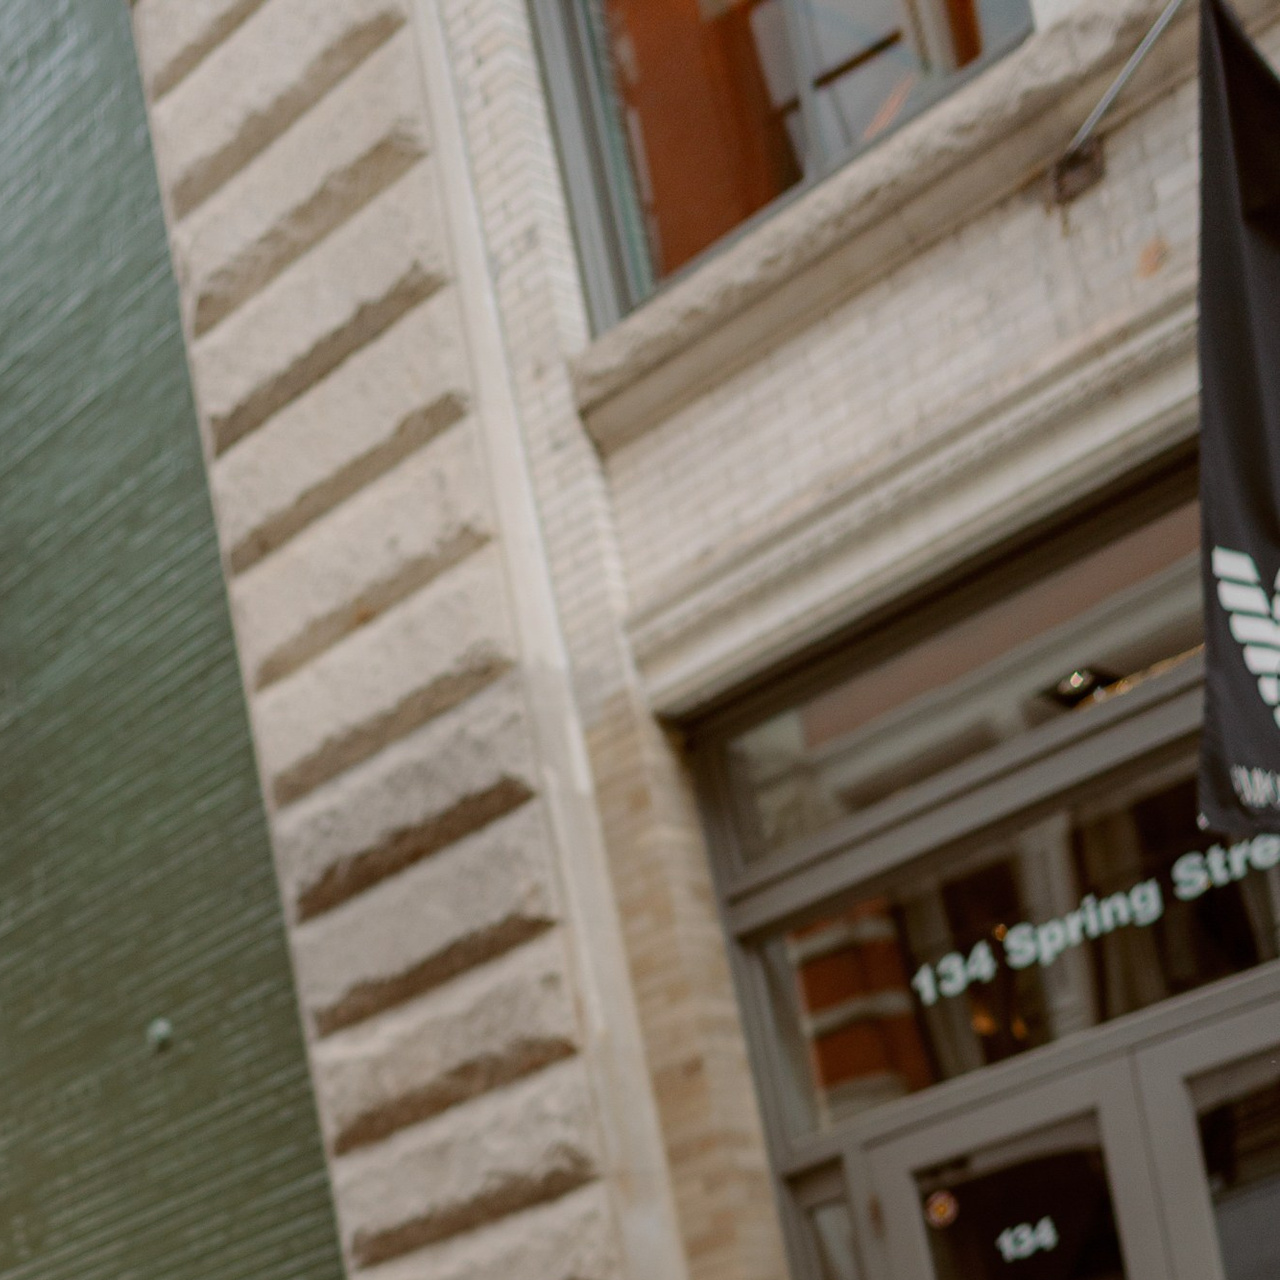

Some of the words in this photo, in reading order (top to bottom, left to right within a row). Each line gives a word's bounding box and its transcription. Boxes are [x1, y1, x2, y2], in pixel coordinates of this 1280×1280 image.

[911, 940, 998, 1006] 134
[1004, 877, 1164, 970] Spring
[994, 1214, 1059, 1263] 134
